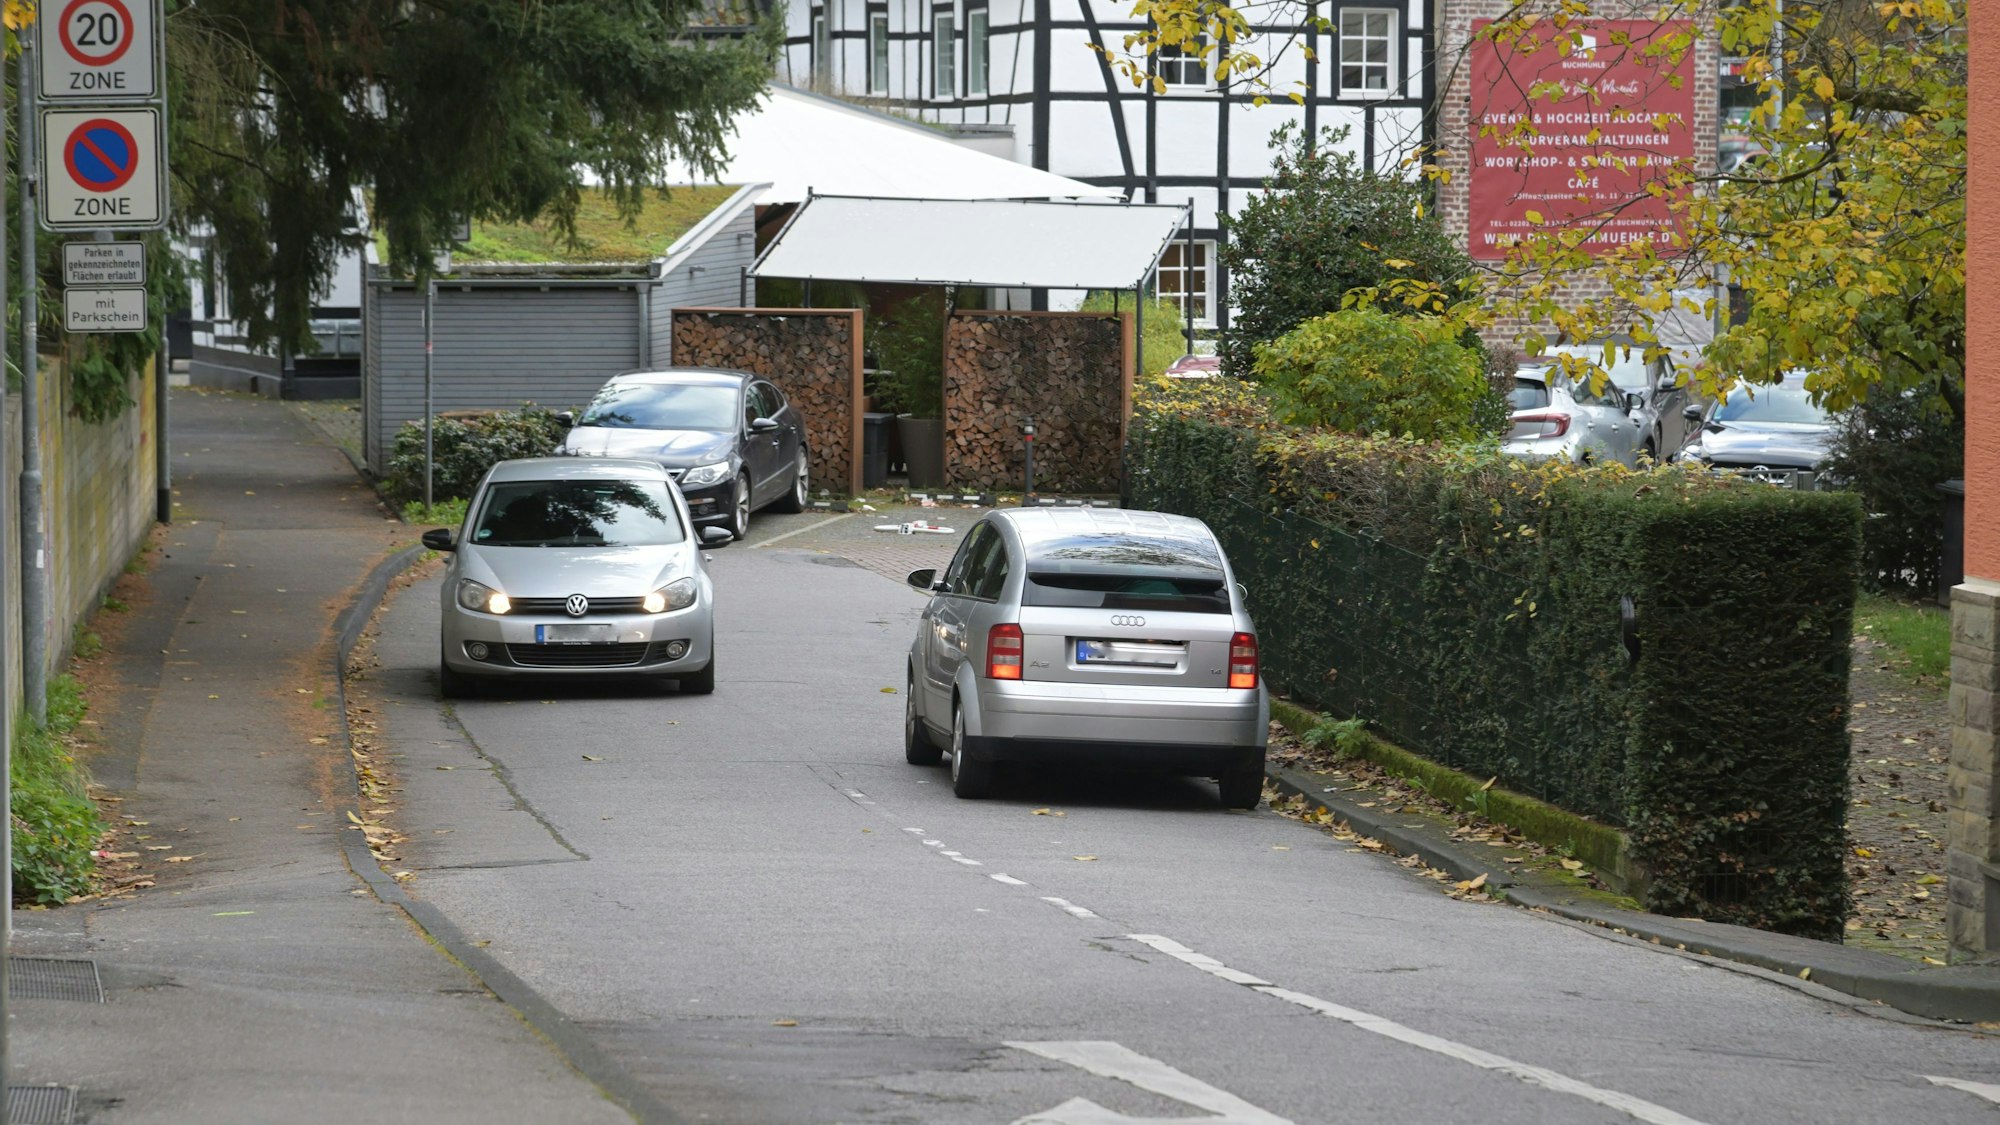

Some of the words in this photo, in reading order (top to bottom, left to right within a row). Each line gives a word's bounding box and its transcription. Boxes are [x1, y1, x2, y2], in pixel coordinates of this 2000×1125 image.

[76, 13, 118, 46] 20
[69, 72, 126, 90] ZONE
[1533, 113, 1542, 124] &
[1547, 112, 1682, 124] HOCHZEITSLOCATN
[1567, 156, 1577, 168] &
[1567, 176, 1599, 189] CAFÉ
[74, 198, 131, 216] ZONE
[84, 248, 113, 257] Parken
[115, 248, 124, 257] in
[68, 259, 141, 271] gekennzeichneten
[72, 270, 106, 281] Flächen
[107, 270, 137, 280] erlaubt
[96, 298, 116, 309] mit
[72, 311, 140, 323] Parkschein
